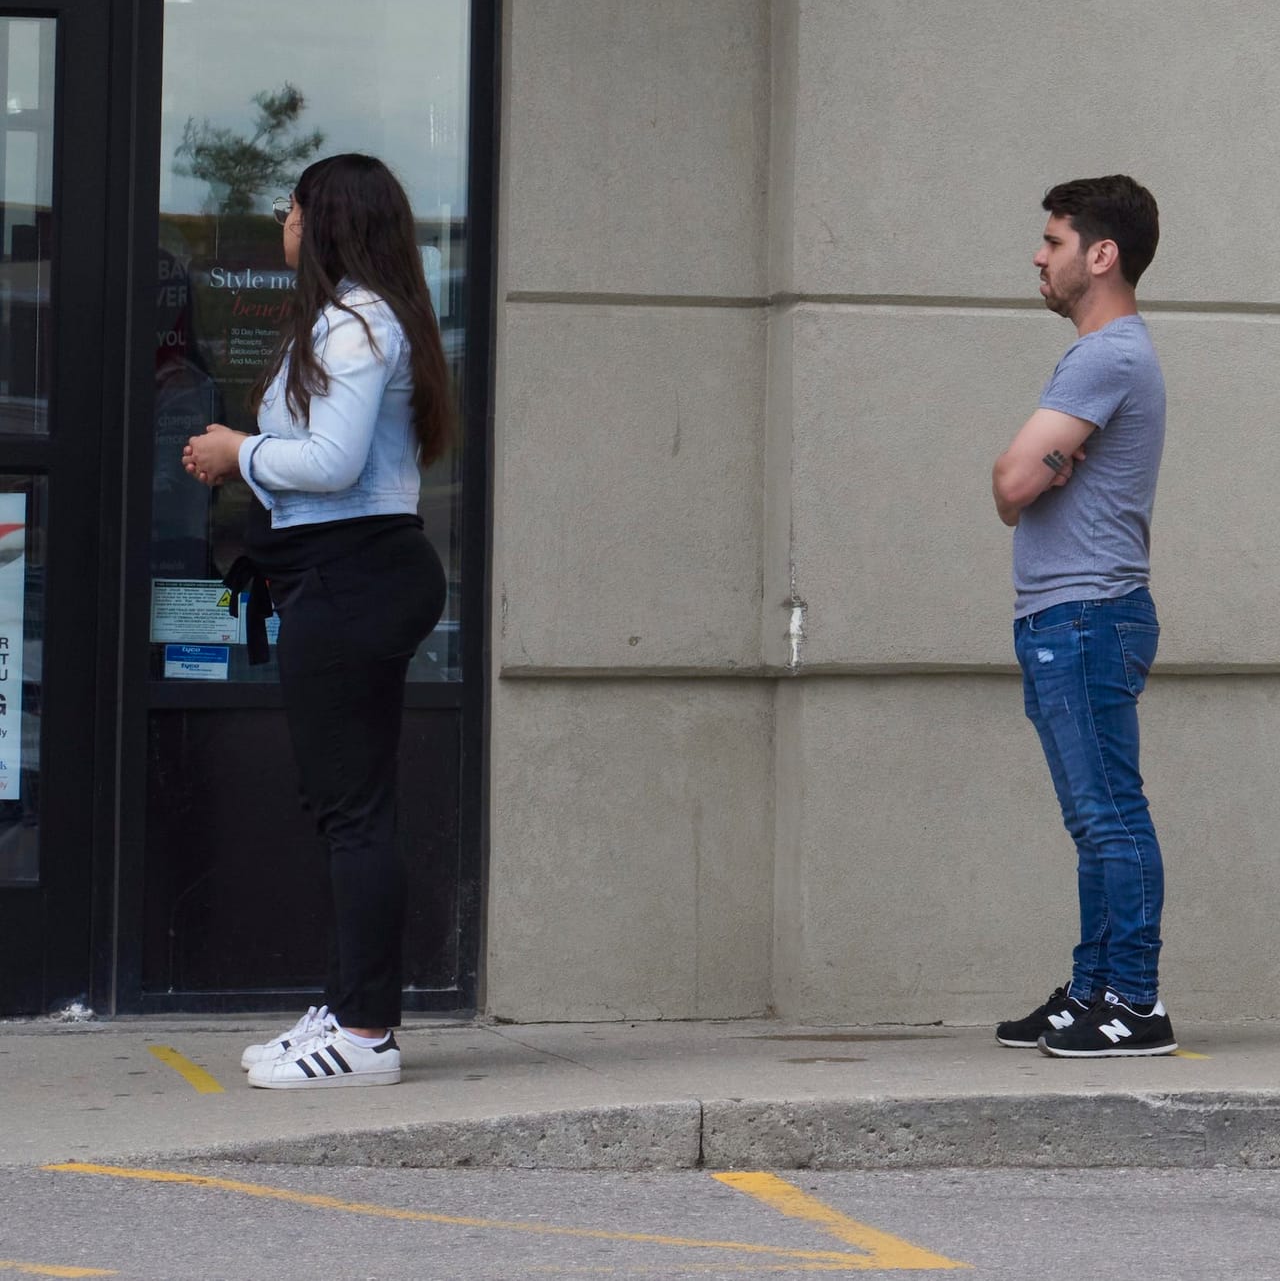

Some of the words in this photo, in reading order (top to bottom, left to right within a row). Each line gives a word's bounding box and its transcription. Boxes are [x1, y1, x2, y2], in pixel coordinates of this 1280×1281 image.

[210, 267, 264, 296] Style
[1047, 1009, 1076, 1030] N
[1098, 1018, 1133, 1044] N
